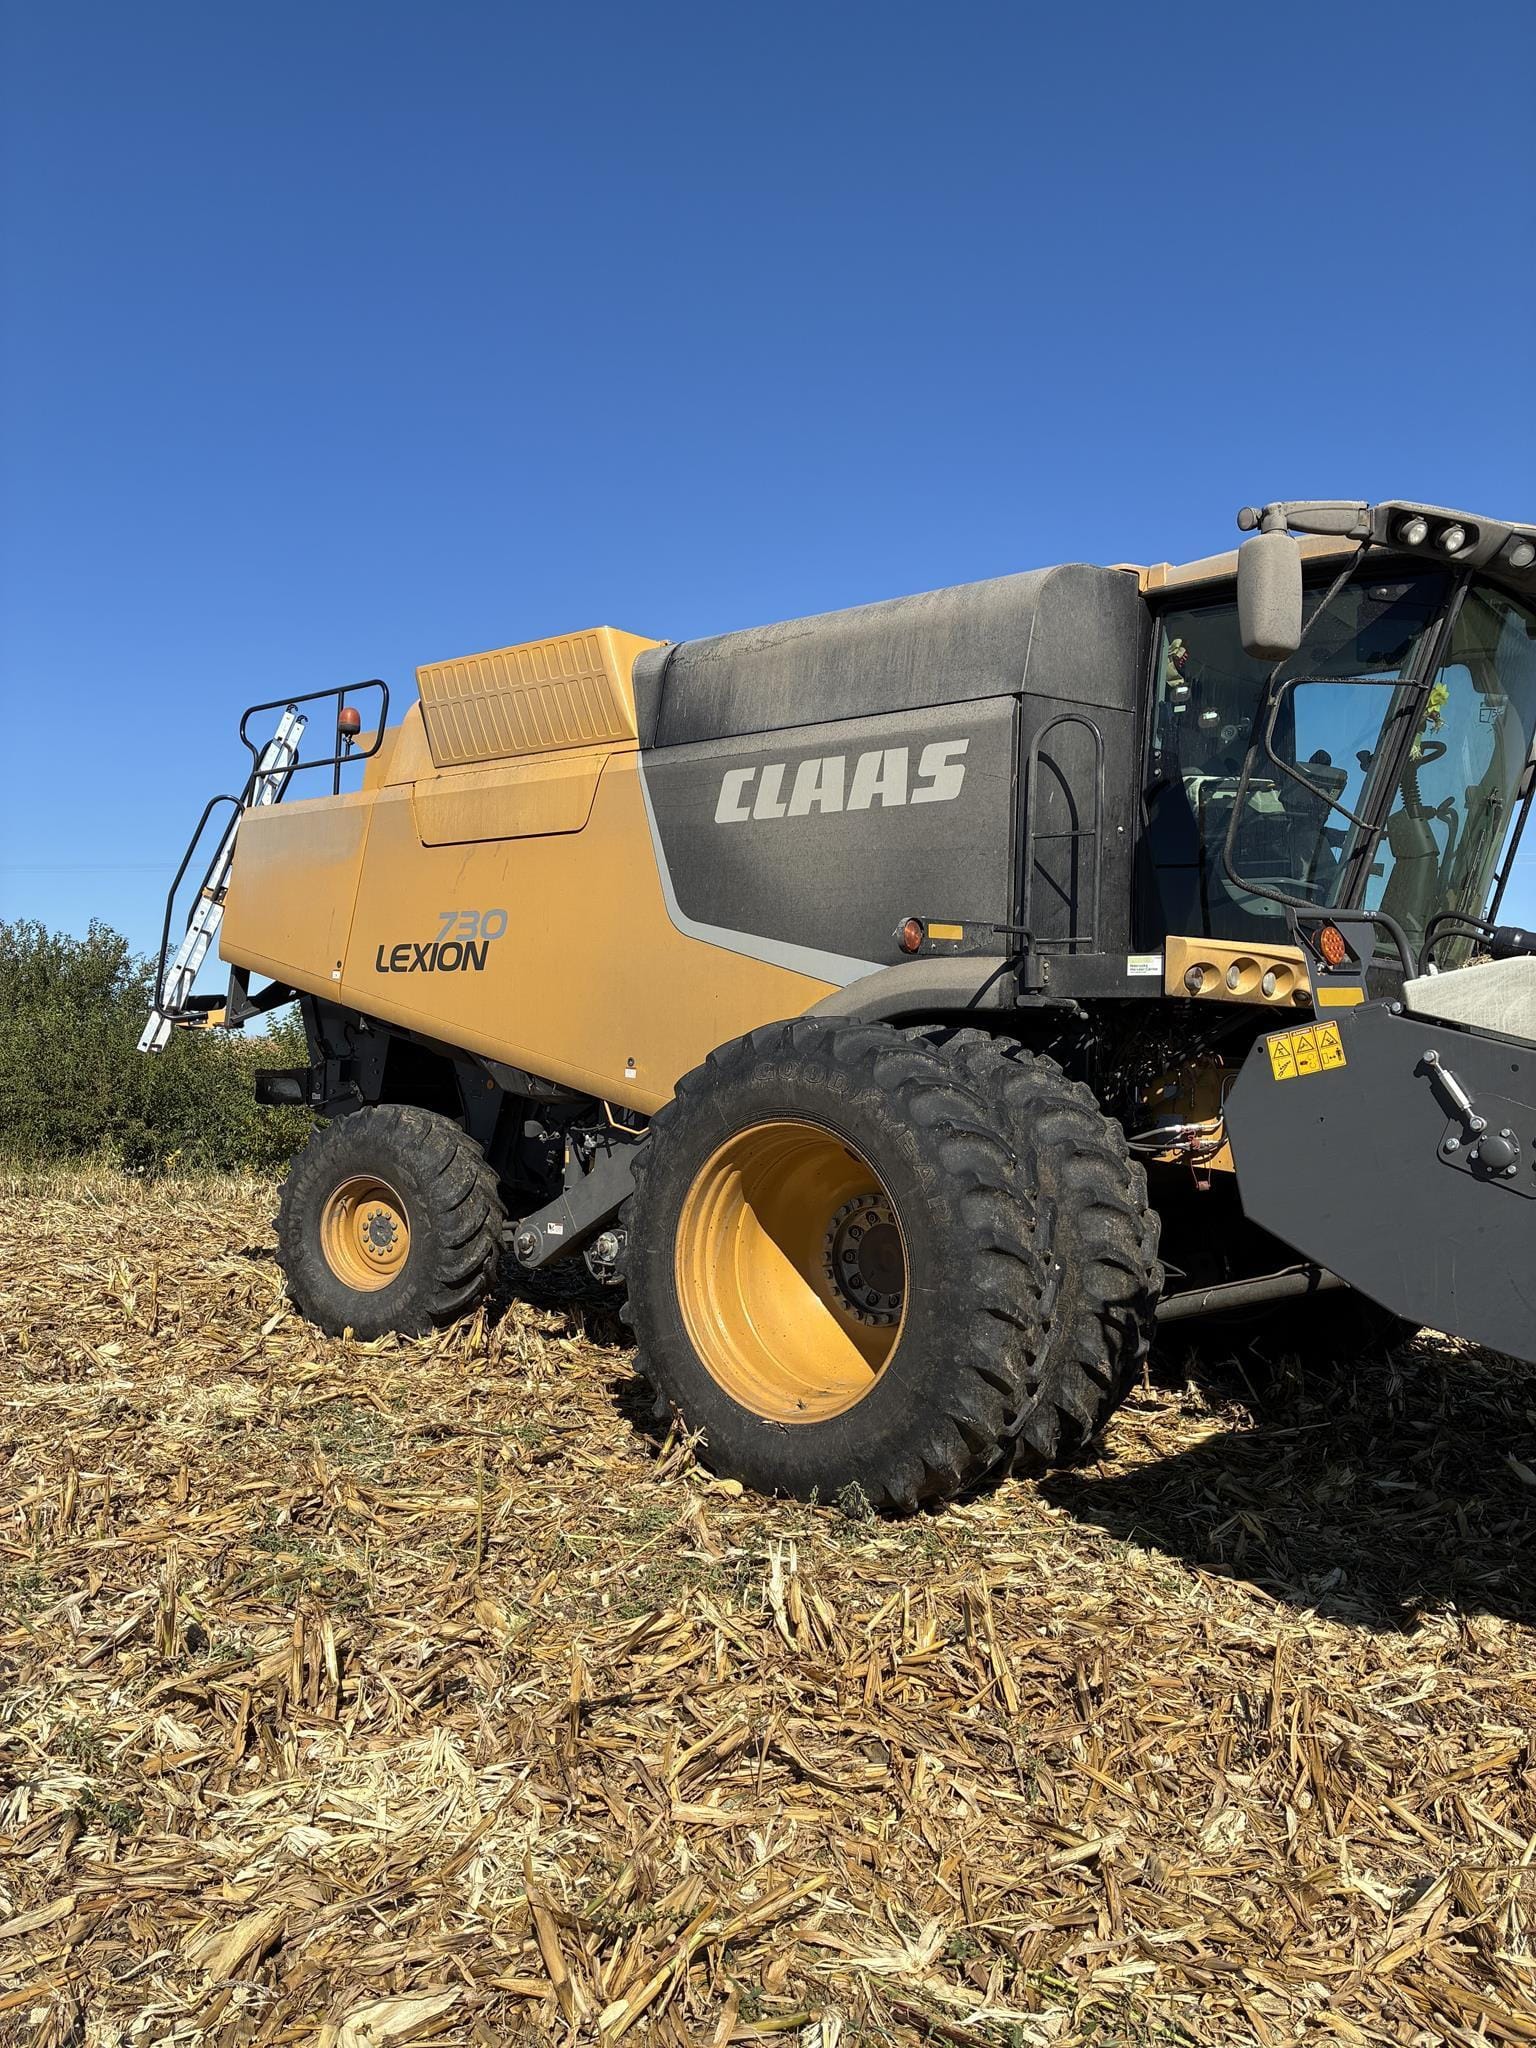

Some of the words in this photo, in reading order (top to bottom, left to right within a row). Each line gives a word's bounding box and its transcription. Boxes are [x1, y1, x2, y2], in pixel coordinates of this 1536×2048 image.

[714, 739, 970, 824] CLAAS
[435, 908, 508, 941] 730
[375, 940, 490, 973] LEXION
